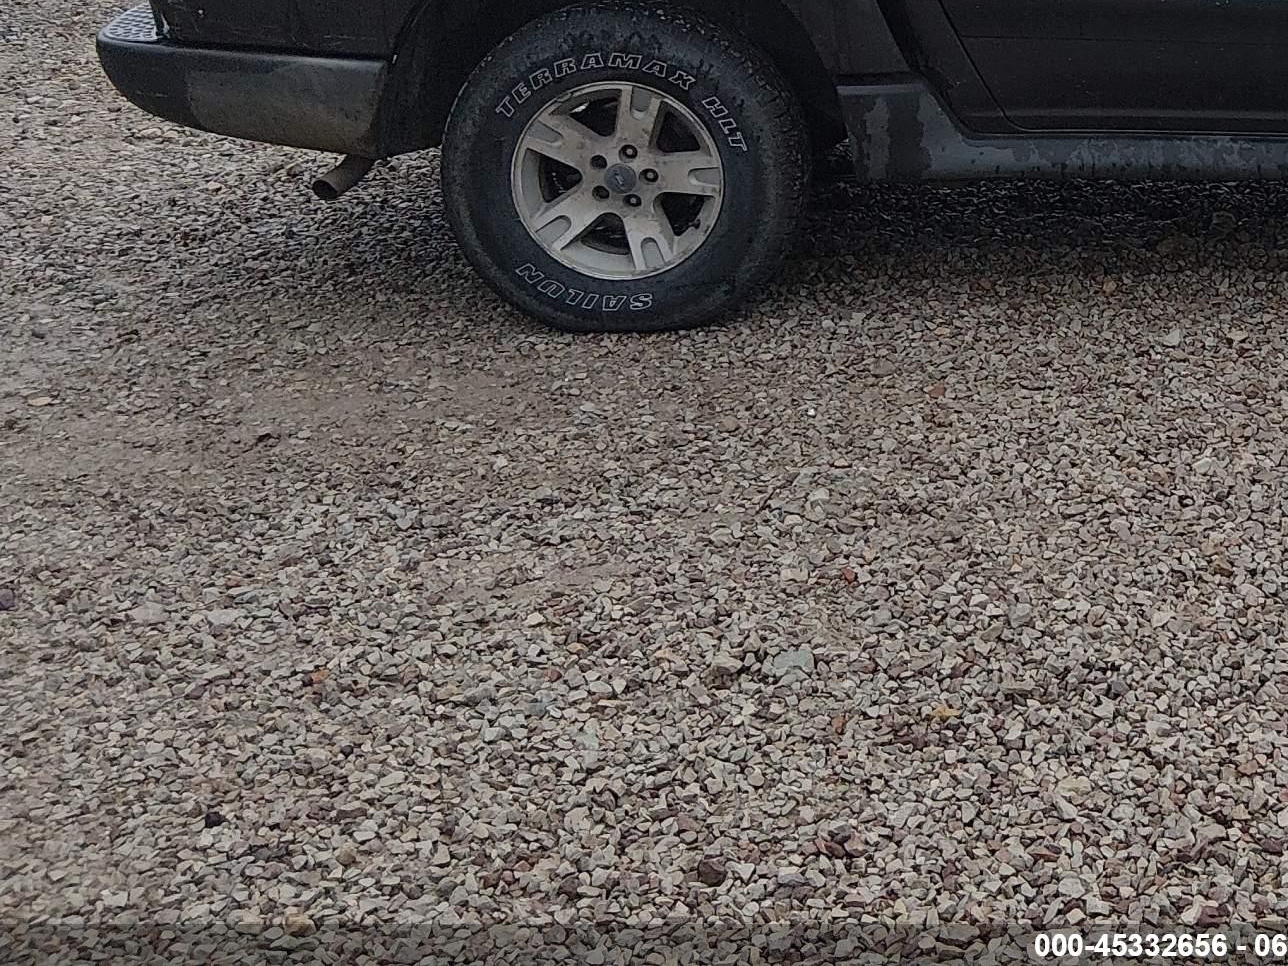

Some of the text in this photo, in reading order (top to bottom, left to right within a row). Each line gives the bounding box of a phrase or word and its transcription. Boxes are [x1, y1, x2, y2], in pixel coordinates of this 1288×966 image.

[496, 52, 748, 152] TERRAMAX HLT
[516, 263, 653, 312] SAILUN
